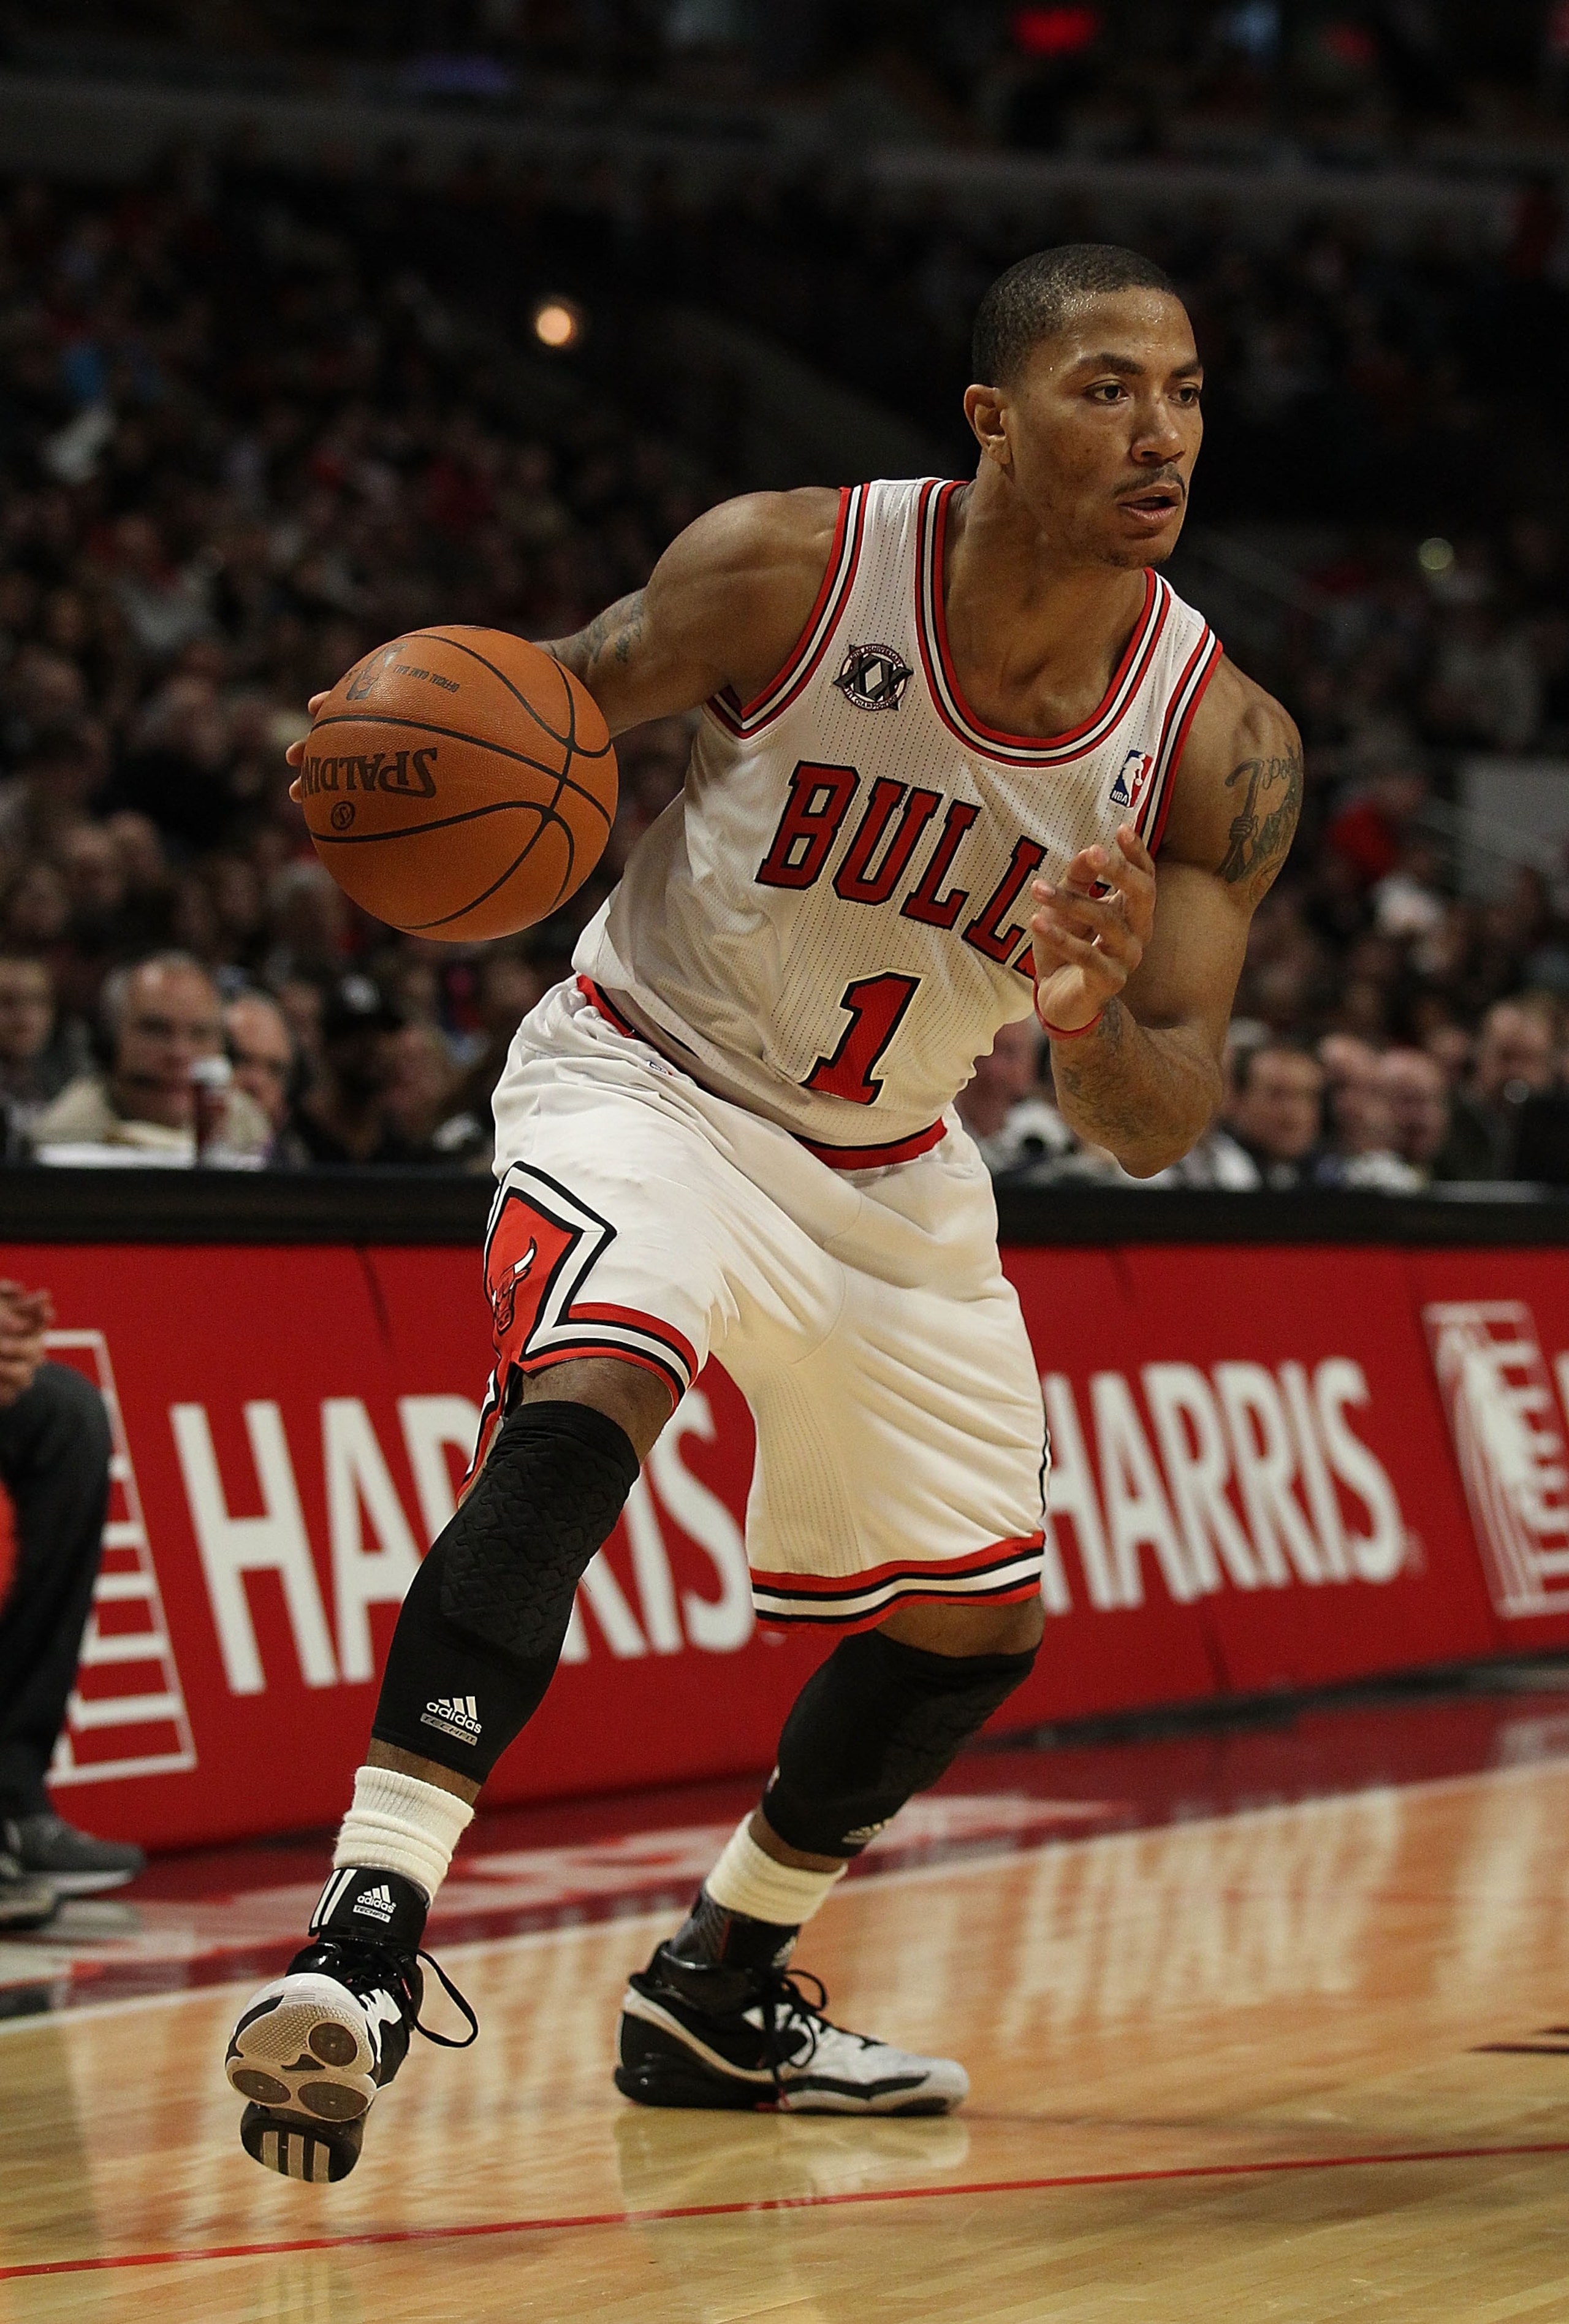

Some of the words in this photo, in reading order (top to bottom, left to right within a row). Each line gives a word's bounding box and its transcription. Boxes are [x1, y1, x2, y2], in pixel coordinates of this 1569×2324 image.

[1111, 790, 1128, 804] NBA
[754, 760, 1049, 981] BULL
[799, 971, 922, 1105] 1
[169, 1386, 756, 1696] HAIS
[1043, 1356, 1408, 1617] HARRIS
[426, 1701, 482, 1734] adidas
[357, 1895, 395, 1913] adidas
